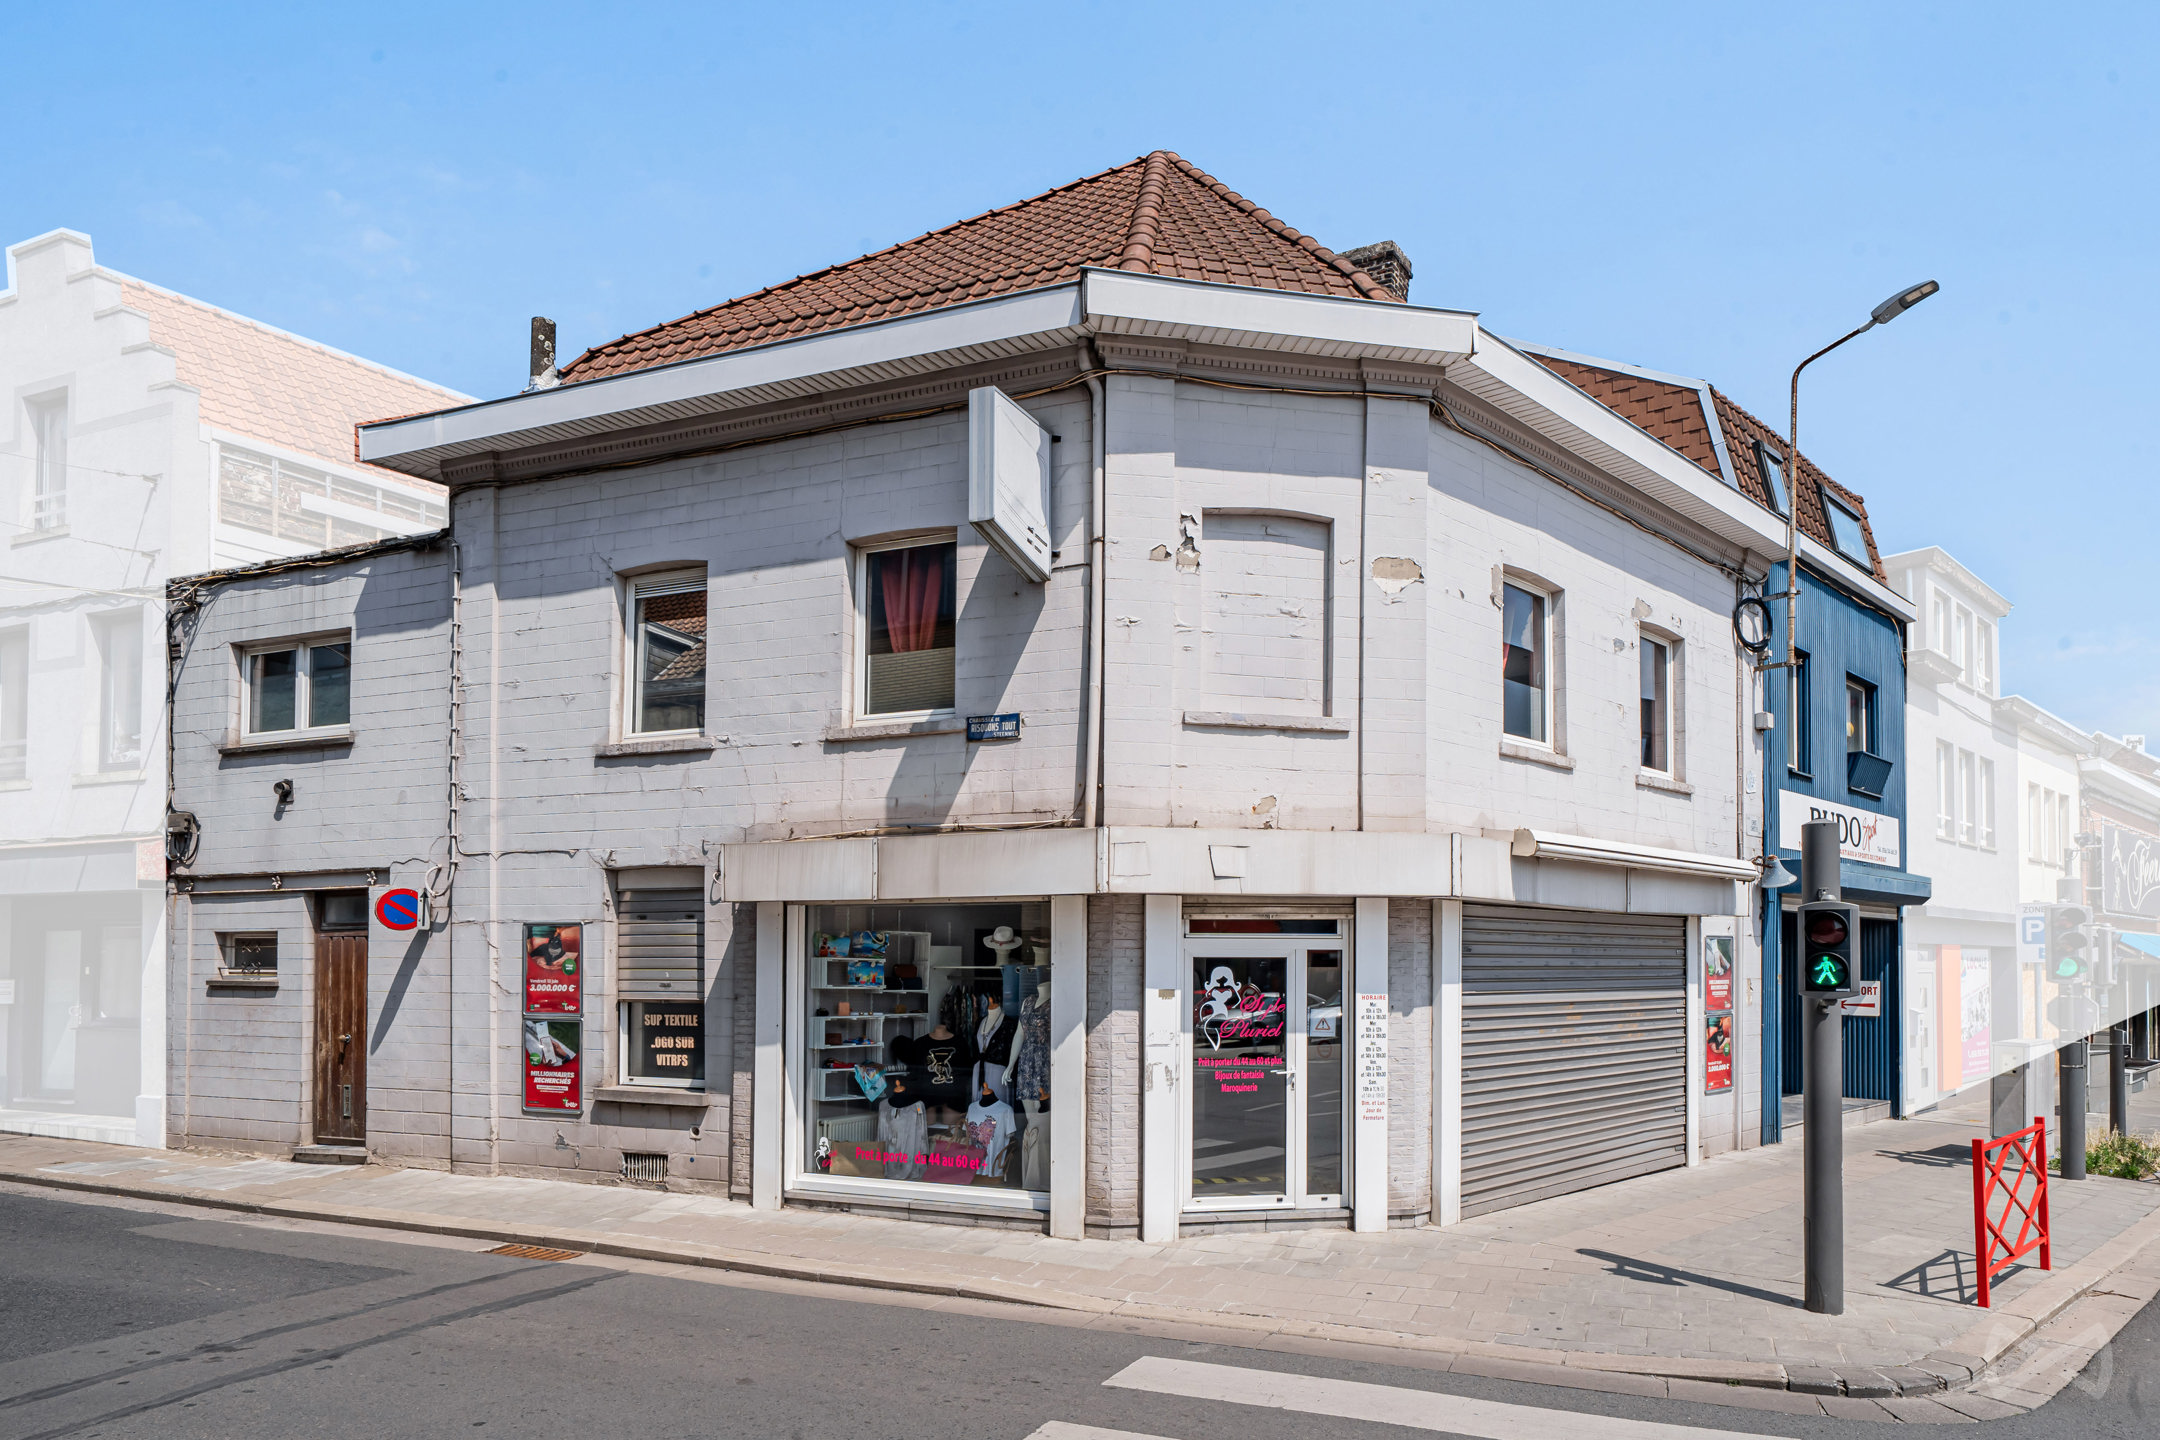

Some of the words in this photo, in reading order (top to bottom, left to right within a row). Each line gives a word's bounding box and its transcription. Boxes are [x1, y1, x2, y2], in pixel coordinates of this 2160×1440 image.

[971, 722, 999, 732] RISQUONS
[1002, 721, 1016, 731] TOUT
[2023, 906, 2046, 914] ZONE
[530, 984, 567, 992] 3.000.000
[568, 984, 576, 992] €
[1860, 986, 1878, 996] ORT
[1240, 994, 1286, 1021] Style
[664, 1014, 699, 1027] TEXTILE
[1220, 1018, 1285, 1038] Pluriel
[675, 1036, 695, 1049] SUR
[1198, 1057, 1210, 1066] Prêt
[1215, 1057, 1232, 1068] porter
[1233, 1056, 1240, 1066] du
[1241, 1057, 1248, 1065] 44
[1257, 1056, 1264, 1065] 60
[1264, 1057, 1270, 1065] et
[1271, 1055, 1283, 1067] plus
[1215, 1070, 1233, 1082] Bijoux
[1233, 1070, 1240, 1080] de
[1241, 1069, 1264, 1079] fantaisie
[1221, 1082, 1258, 1094] Maroquinerie
[855, 1146, 874, 1161] Pret
[875, 1148, 881, 1162] à
[883, 1150, 908, 1165] porte
[914, 1150, 927, 1165] du
[928, 1152, 940, 1166] 44
[942, 1155, 954, 1167] au
[955, 1154, 968, 1168] 60
[969, 1157, 980, 1170] et
